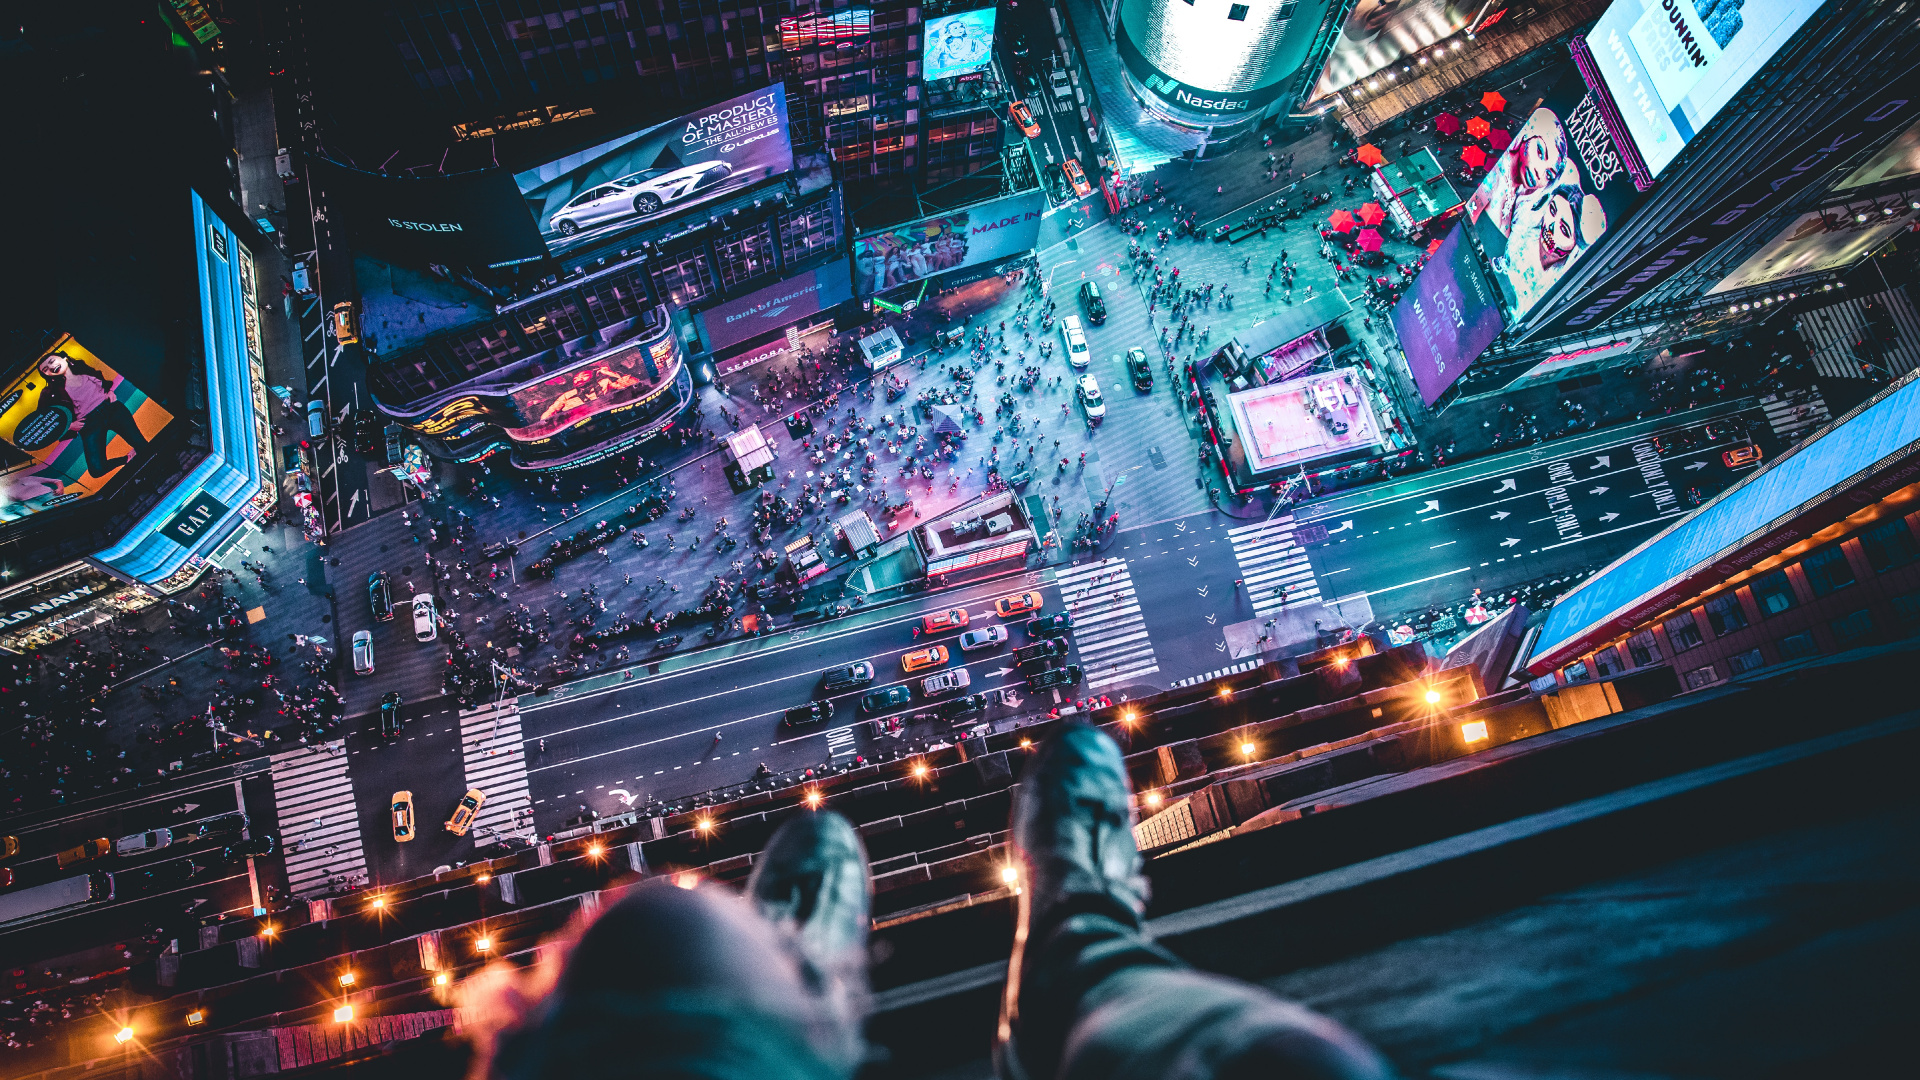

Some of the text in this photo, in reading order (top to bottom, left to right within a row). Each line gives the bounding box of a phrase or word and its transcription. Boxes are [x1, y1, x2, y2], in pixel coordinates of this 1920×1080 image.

[1608, 28, 1637, 84] WITH
[686, 92, 775, 133] A PRODUCT
[1176, 89, 1250, 110] Nasdaq
[682, 103, 776, 143] OF MASTERY
[704, 116, 778, 146] THE ALL-NEW ES
[1577, 93, 1624, 181] FANTASY
[737, 128, 780, 147] LEXUS
[1565, 107, 1608, 191] MAKERS
[1634, 235, 1708, 284] DUTY
[1711, 132, 1863, 226] BLACK
[388, 218, 463, 232] IS STOLEN
[972, 209, 1041, 236] MADE IN
[726, 283, 823, 323] Bank of America
[1433, 291, 1457, 342] LOVED
[1442, 284, 1465, 329] MOST
[1432, 317, 1443, 337] IN
[726, 347, 785, 373] SEPHORA
[2, 392, 19, 410] NAVY
[610, 404, 633, 414] NOW
[34, 421, 60, 444] POCKETS
[619, 438, 636, 448] died
[634, 433, 657, 446] Giants
[1547, 462, 1577, 484] ONLY
[1872, 459, 1914, 492] THOMSON
[1544, 487, 1573, 514] ONLY
[1651, 488, 1681, 515] ONLY
[177, 504, 213, 536] GAP
[1554, 513, 1583, 541] ONLY
[1731, 529, 1799, 566] THOMSON REUTERS
[30, 585, 93, 615] NAVY
[1629, 605, 1658, 622] THOMSON
[826, 727, 857, 758] ONLY
